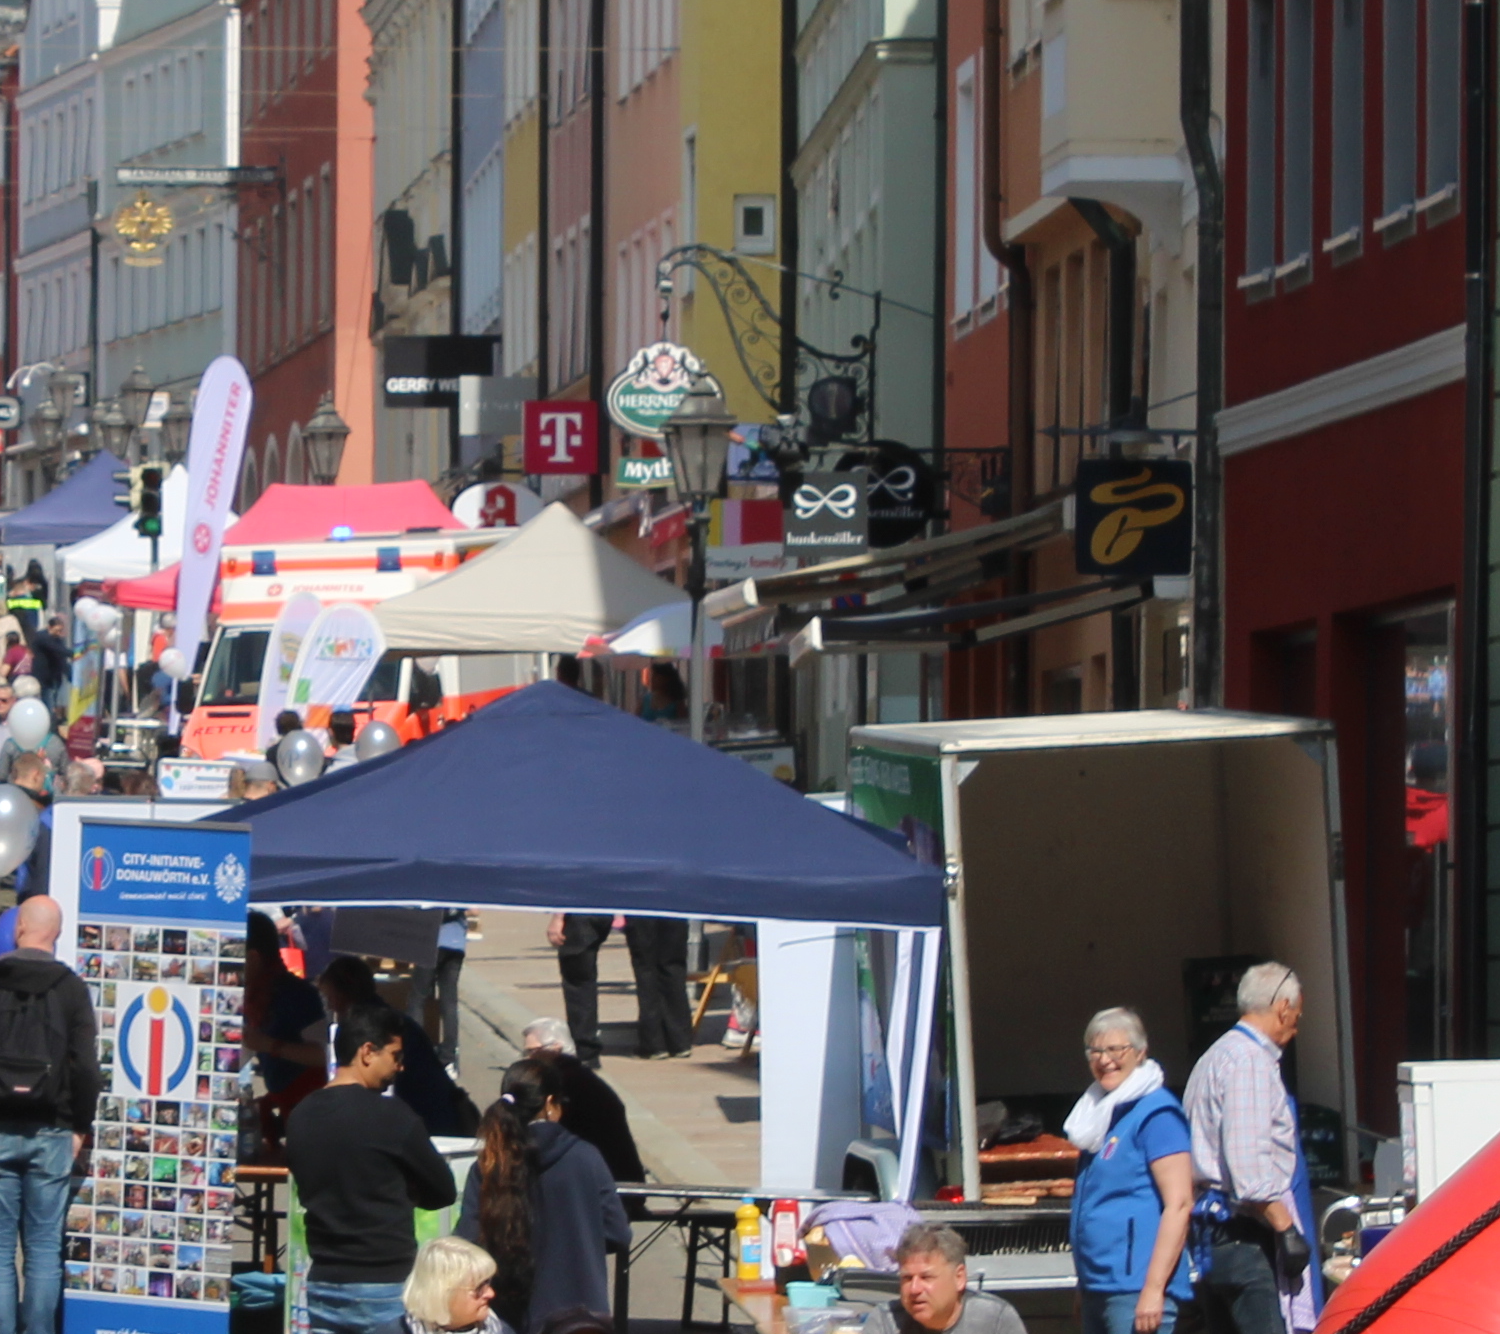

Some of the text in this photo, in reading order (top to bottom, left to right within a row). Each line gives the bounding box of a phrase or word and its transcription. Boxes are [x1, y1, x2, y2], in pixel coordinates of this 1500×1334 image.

[386, 377, 460, 393] GERRY WE
[540, 412, 582, 462] T
[205, 381, 242, 512] JOHANNITER
[785, 531, 864, 546] hunkemöller
[292, 584, 364, 593] JOHANNITER
[192, 725, 254, 737] RETTU
[122, 853, 205, 868] CITY-INITIATIVE-
[116, 869, 210, 885] DONAUWÖRTH e.V.
